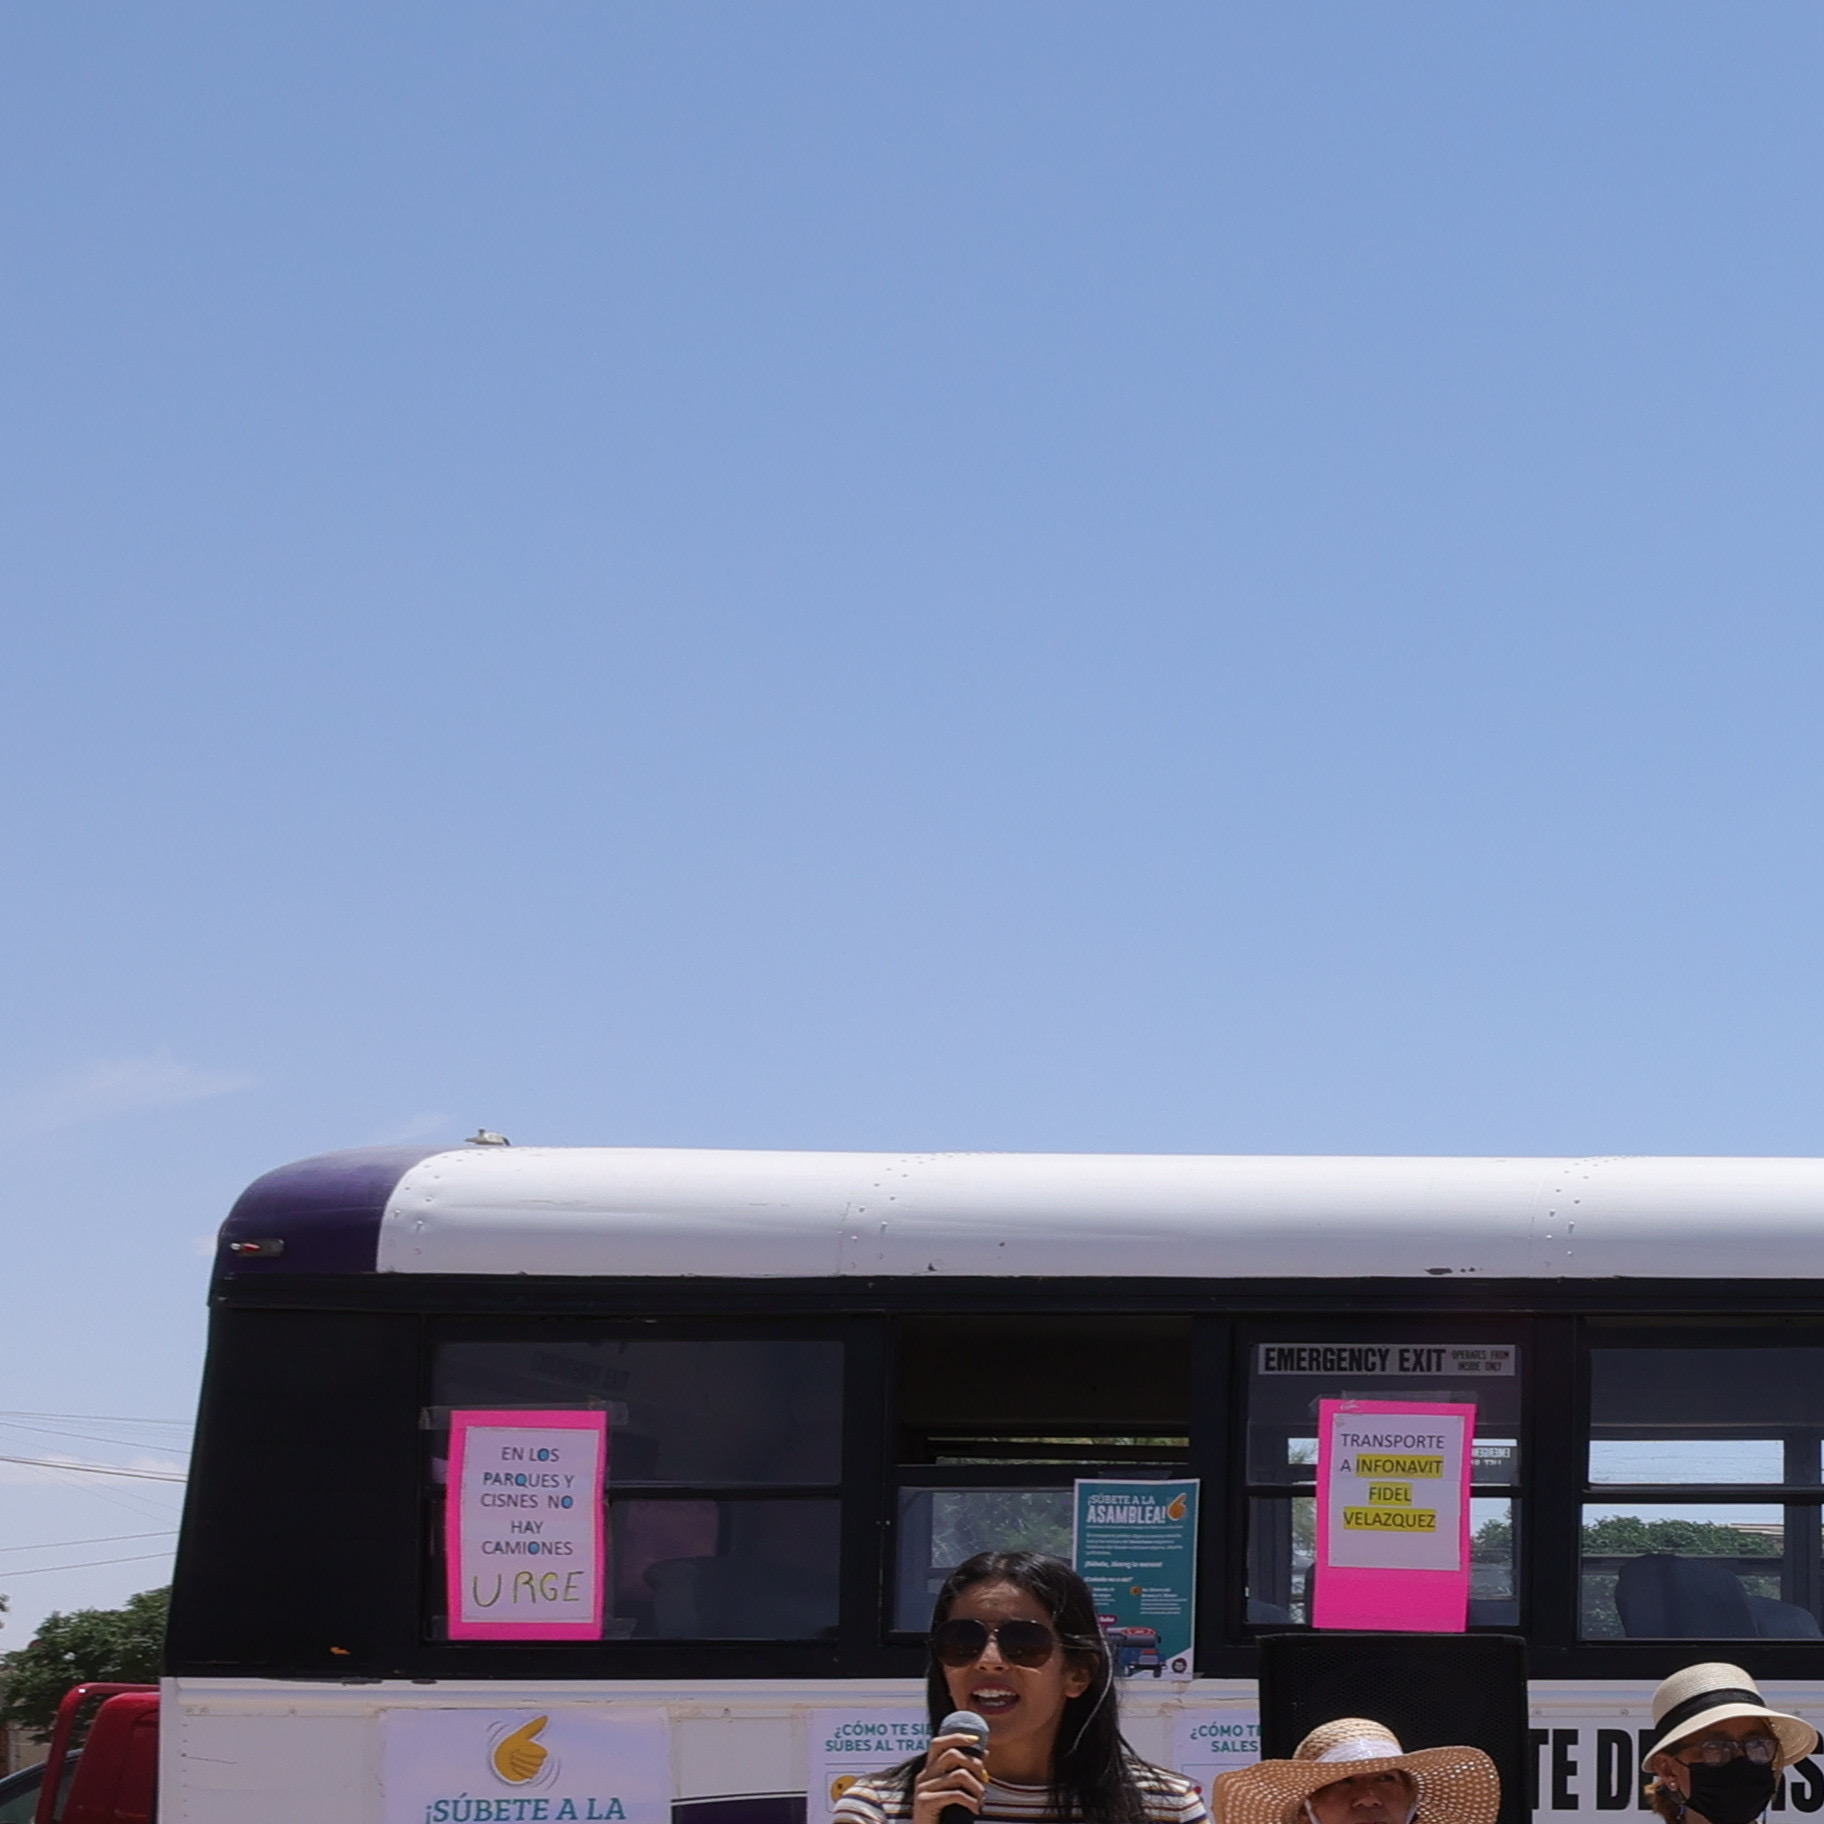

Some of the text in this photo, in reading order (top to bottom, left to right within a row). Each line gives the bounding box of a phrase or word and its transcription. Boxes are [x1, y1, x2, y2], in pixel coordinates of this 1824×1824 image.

[1264, 1347, 1447, 1373] EMERGENCY EXIT
[1341, 1433, 1446, 1449] TRANSPORTE
[501, 1447, 560, 1462] EN LOS
[1340, 1458, 1444, 1474] A INFONAVIT
[482, 1472, 575, 1488] PARQUES Y
[480, 1493, 574, 1509] CISNES NO
[1088, 1493, 1155, 1505] ¡SÚBETE A LA
[1368, 1486, 1412, 1502] FIDEL
[1087, 1505, 1166, 1524] ASAMBLEA!
[1343, 1511, 1436, 1529] VELAZQUEZ
[511, 1520, 544, 1534] HAY
[481, 1540, 574, 1556] CAMIONES
[472, 1570, 585, 1608] URGE
[834, 1721, 908, 1739] ¿CÓMO TE
[1189, 1723, 1241, 1740] ¿CÓMO
[824, 1738, 894, 1753] SUBES AL
[1210, 1740, 1259, 1754] SALES
[554, 1798, 578, 1821] A
[586, 1797, 627, 1821] LA
